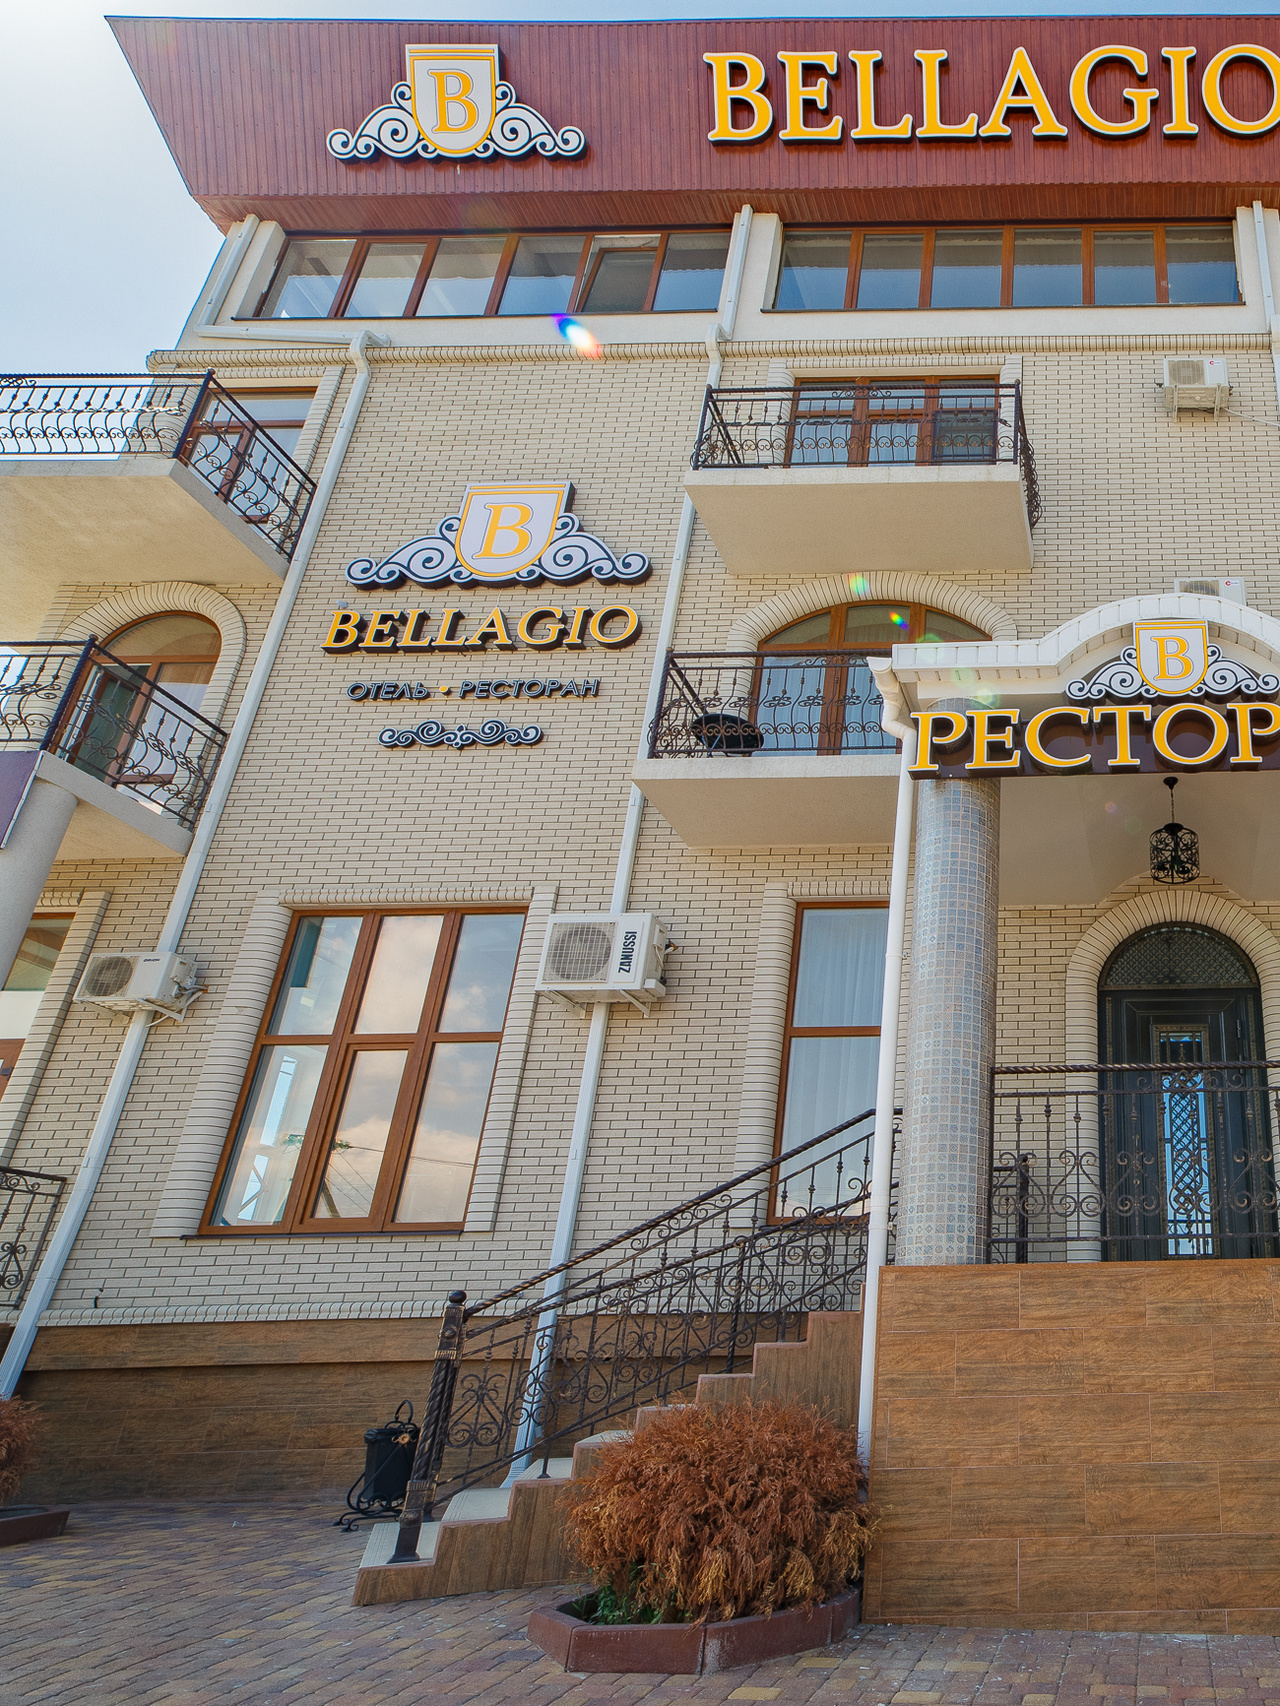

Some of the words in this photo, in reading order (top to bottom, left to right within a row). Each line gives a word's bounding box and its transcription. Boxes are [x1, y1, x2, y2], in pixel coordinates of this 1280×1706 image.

[427, 69, 479, 134] B
[472, 502, 534, 559] B
[320, 605, 640, 651] BELLAGIO
[1150, 635, 1194, 680] B
[346, 680, 429, 700] ОТЕЛЬ
[458, 678, 599, 698] РЕСТОРАН
[617, 930, 638, 974] ZANUSSI
